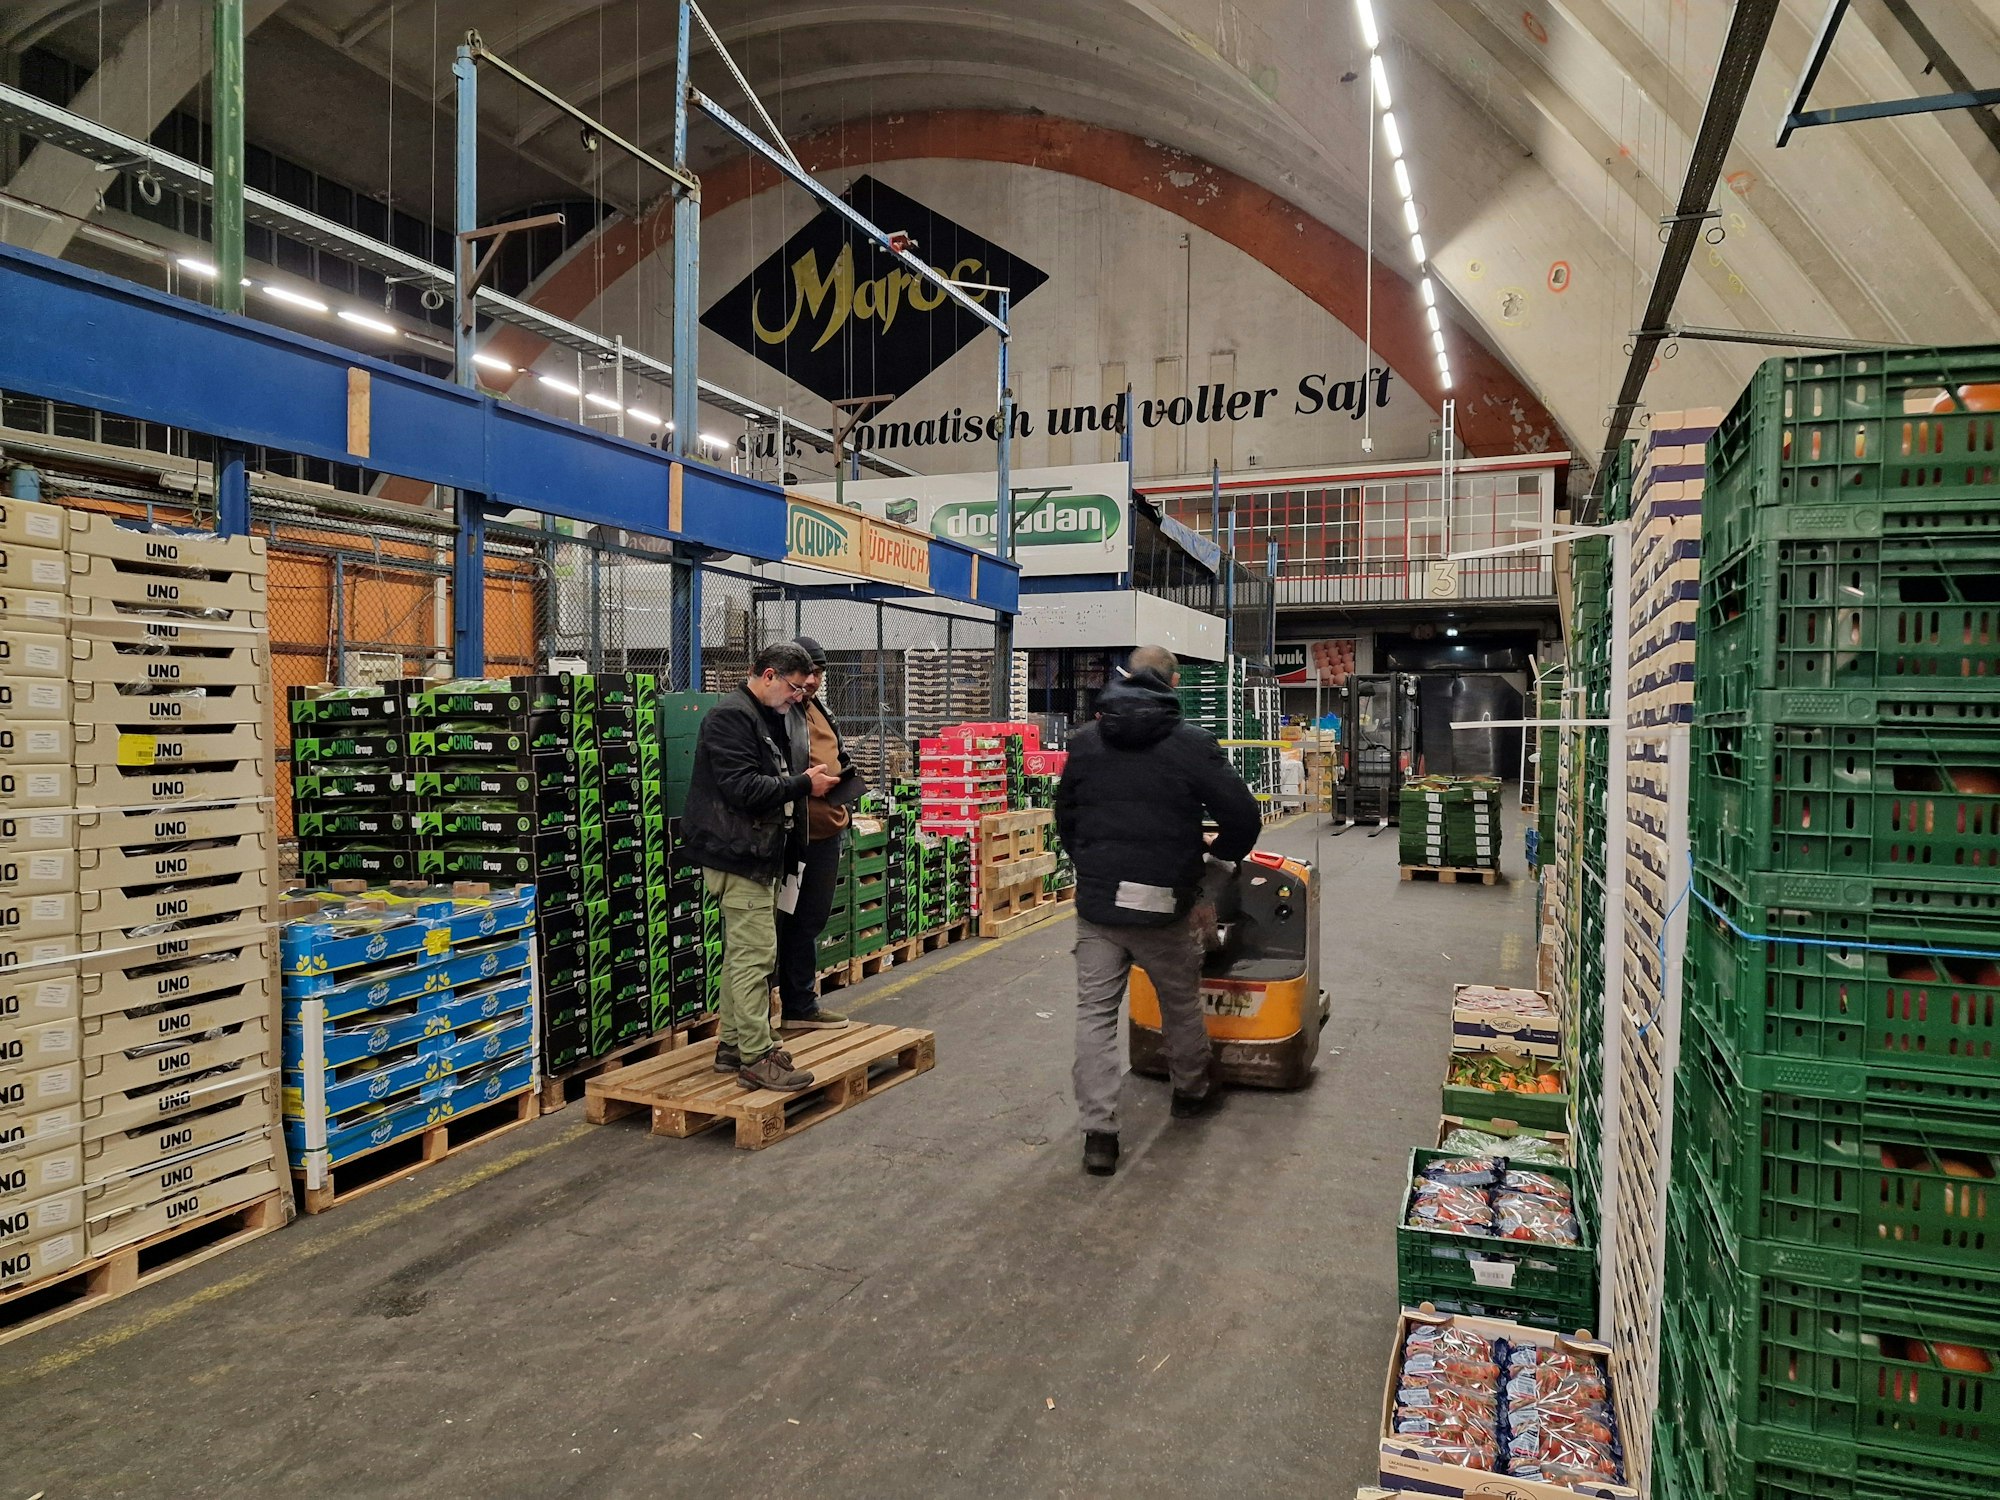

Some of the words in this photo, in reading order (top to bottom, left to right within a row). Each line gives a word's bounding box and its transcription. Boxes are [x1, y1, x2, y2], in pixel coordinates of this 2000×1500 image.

[752, 241, 990, 353] Maroc
[1047, 392, 1127, 436] und
[1137, 383, 1278, 428] voller
[1295, 366, 1394, 420] Saft
[146, 543, 178, 559] UNO
[1432, 562, 1457, 597] 3
[147, 584, 179, 599] UNO
[148, 624, 179, 637] UNO
[148, 664, 180, 678] UNO
[150, 703, 181, 716] UNO
[332, 702, 350, 717] CNG
[351, 706, 369, 717] Group
[453, 695, 473, 711] CNG
[474, 701, 493, 713] Group
[336, 739, 355, 755] CNG
[355, 744, 373, 755] Group
[453, 735, 473, 750] CNG
[473, 740, 492, 751] Group
[152, 782, 184, 795] UNO
[459, 775, 480, 791] CNG
[481, 781, 501, 793] Group
[155, 821, 186, 836] UNO
[340, 816, 359, 831] CNG
[359, 821, 378, 832] Group
[461, 815, 481, 831] CNG
[482, 821, 501, 833] Group
[155, 858, 187, 874] UNO
[343, 854, 362, 869] CNG
[362, 858, 380, 869] Group
[463, 855, 482, 871] CNG
[483, 860, 501, 873] Group
[156, 899, 188, 916] UNO
[572, 929, 584, 938] Group
[157, 939, 188, 956] UNO
[573, 969, 585, 979] Group
[158, 975, 189, 994] UNO
[575, 1008, 586, 1018] Group
[159, 1014, 190, 1032] UNO
[576, 1046, 587, 1056] Group
[159, 1052, 190, 1072] UNO
[159, 1090, 190, 1111] UNO
[160, 1129, 192, 1149] UNO
[161, 1165, 193, 1187] UNO
[167, 1196, 198, 1218] UNO
